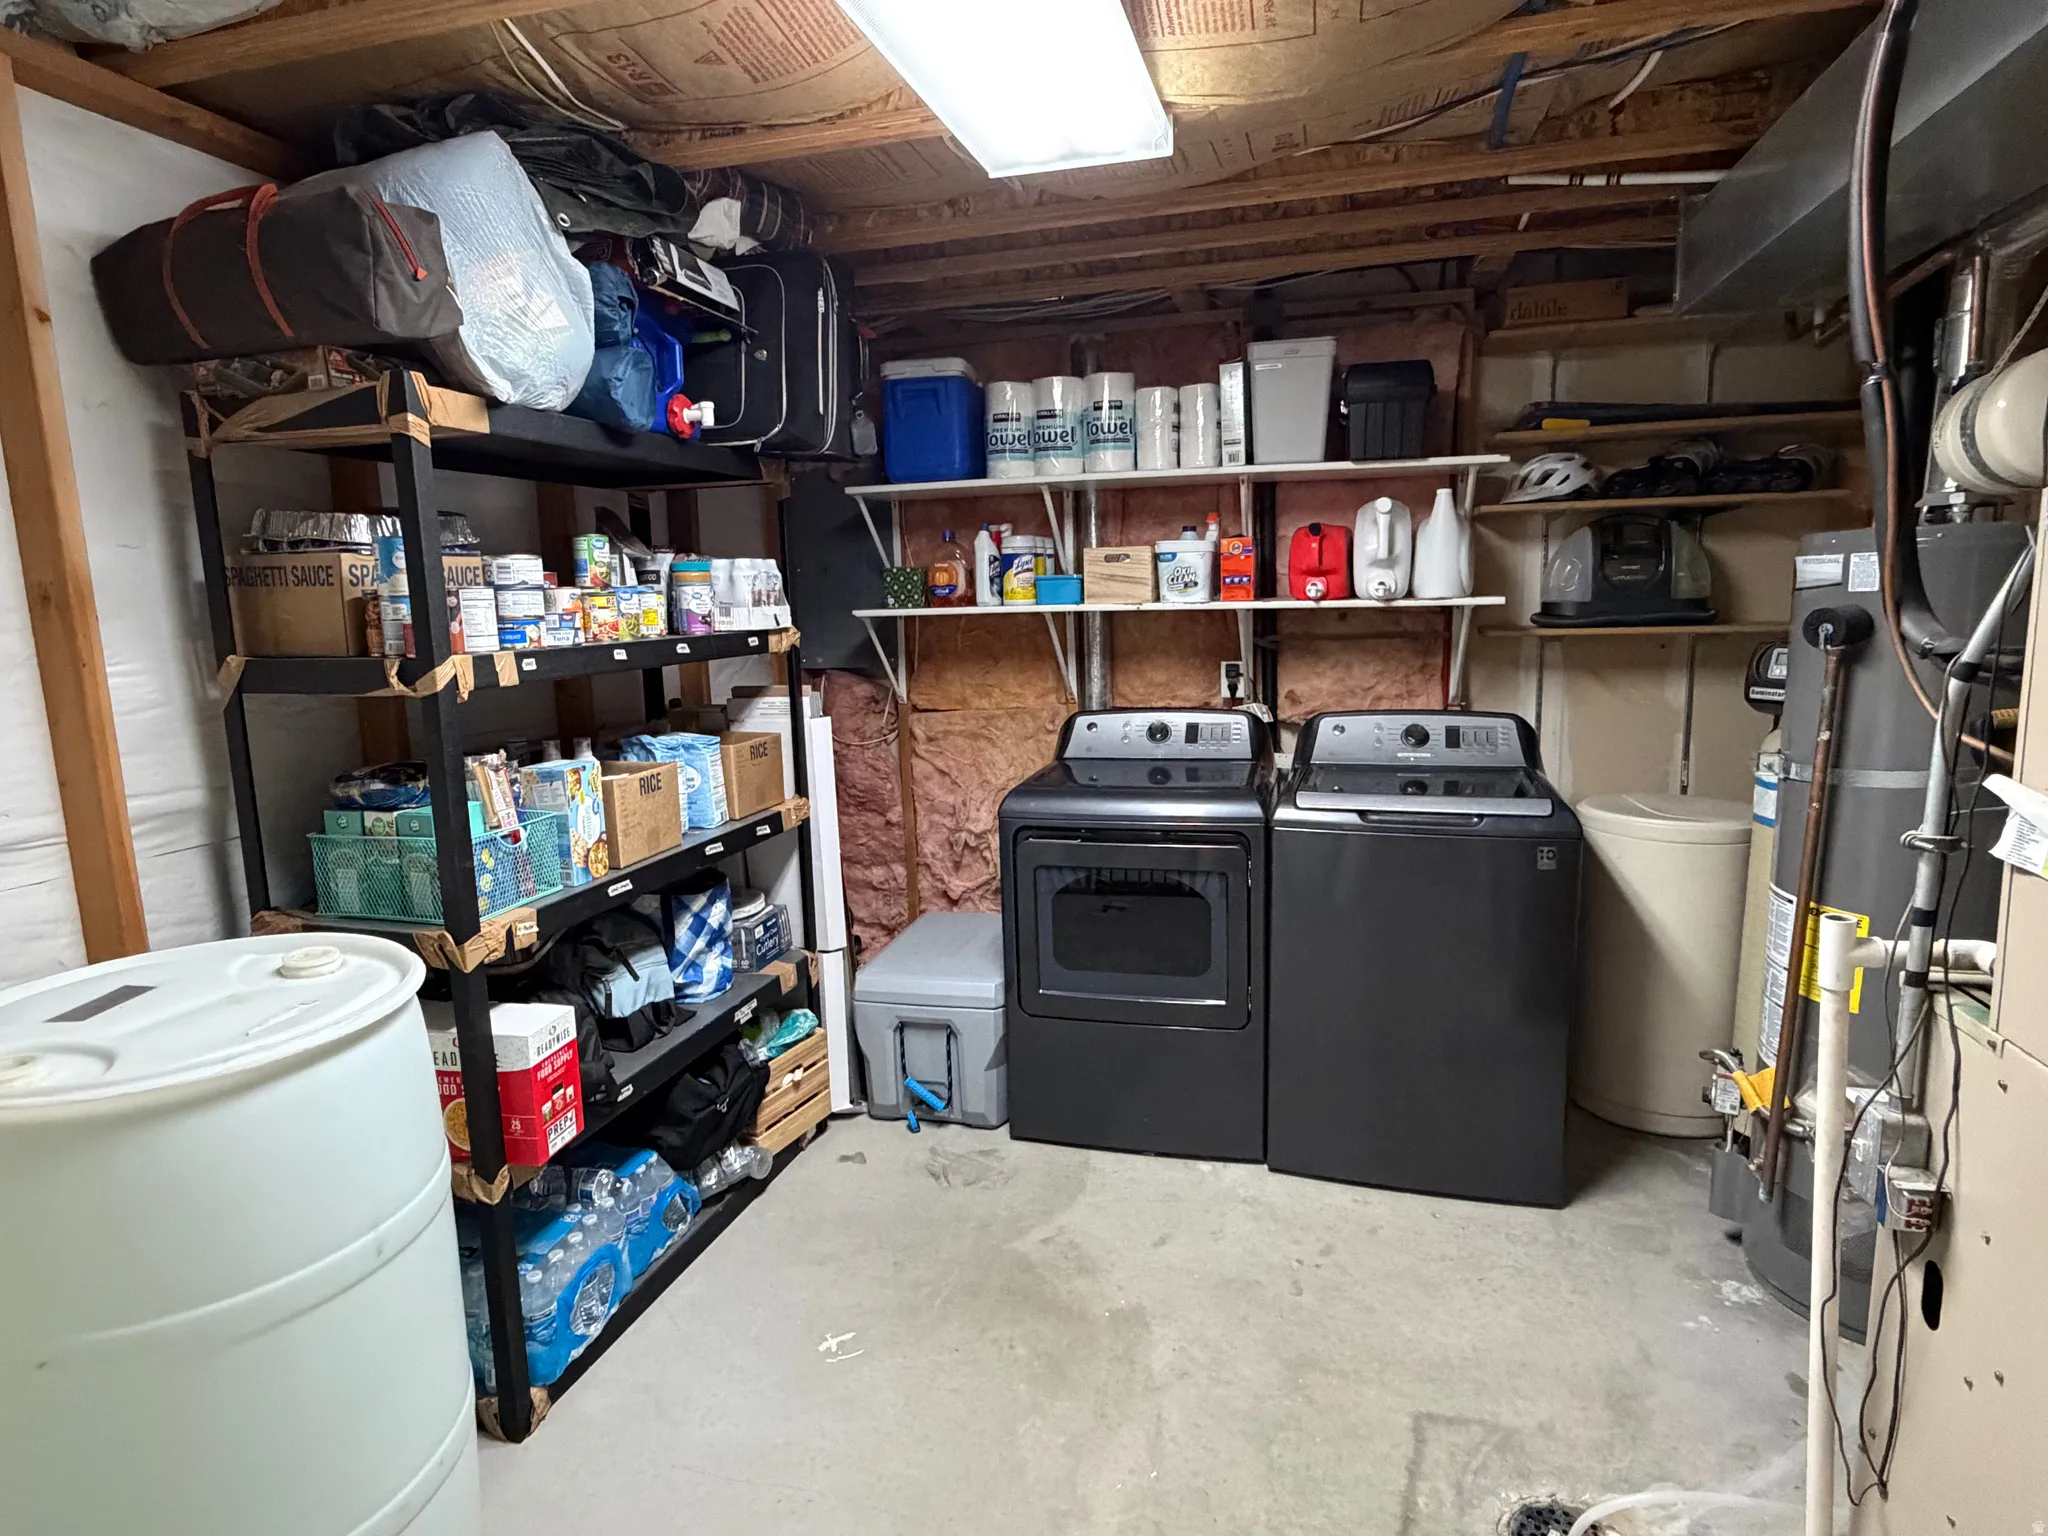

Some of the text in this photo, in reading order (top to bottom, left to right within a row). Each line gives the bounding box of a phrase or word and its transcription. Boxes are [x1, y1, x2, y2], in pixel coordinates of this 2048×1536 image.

[1034, 426, 1076, 444] owel
[290, 565, 335, 588] SAUCE
[445, 565, 482, 588] AUCE
[1168, 573, 1196, 585] CLEAN
[1174, 566, 1192, 576] OXI
[553, 632, 570, 642] Tuna
[749, 741, 769, 761] RICE
[638, 772, 662, 797] RICE
[756, 934, 779, 956] Cutlery
[536, 1026, 570, 1056] READYWISE
[537, 1048, 573, 1082] FOOD SUPPLY
[511, 1120, 521, 1130] 25
[547, 1116, 569, 1141] PREP
